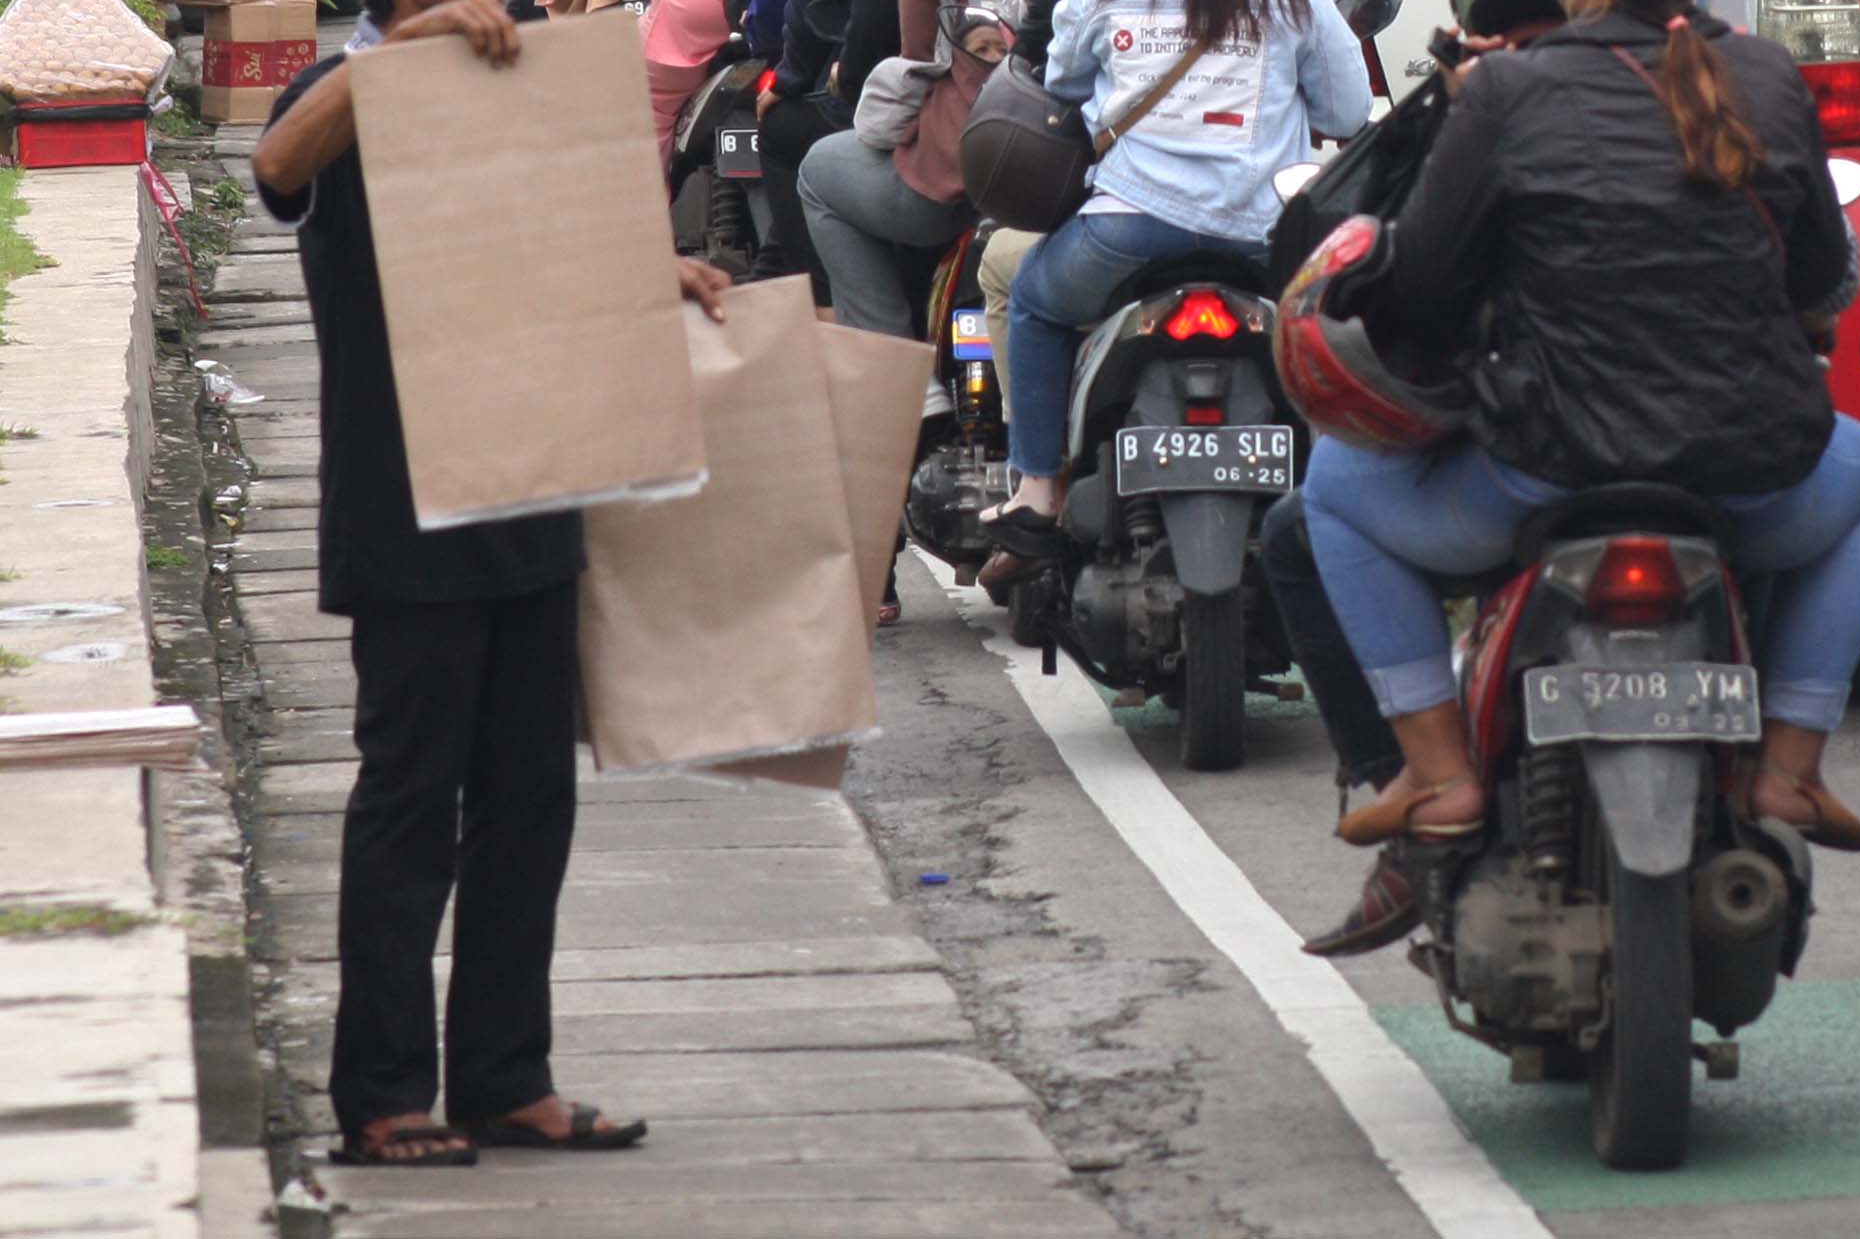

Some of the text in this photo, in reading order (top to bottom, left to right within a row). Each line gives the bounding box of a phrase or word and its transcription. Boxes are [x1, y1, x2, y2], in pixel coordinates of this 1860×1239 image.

[723, 134, 738, 152] B
[1123, 431, 1287, 461] B 4926 SLG
